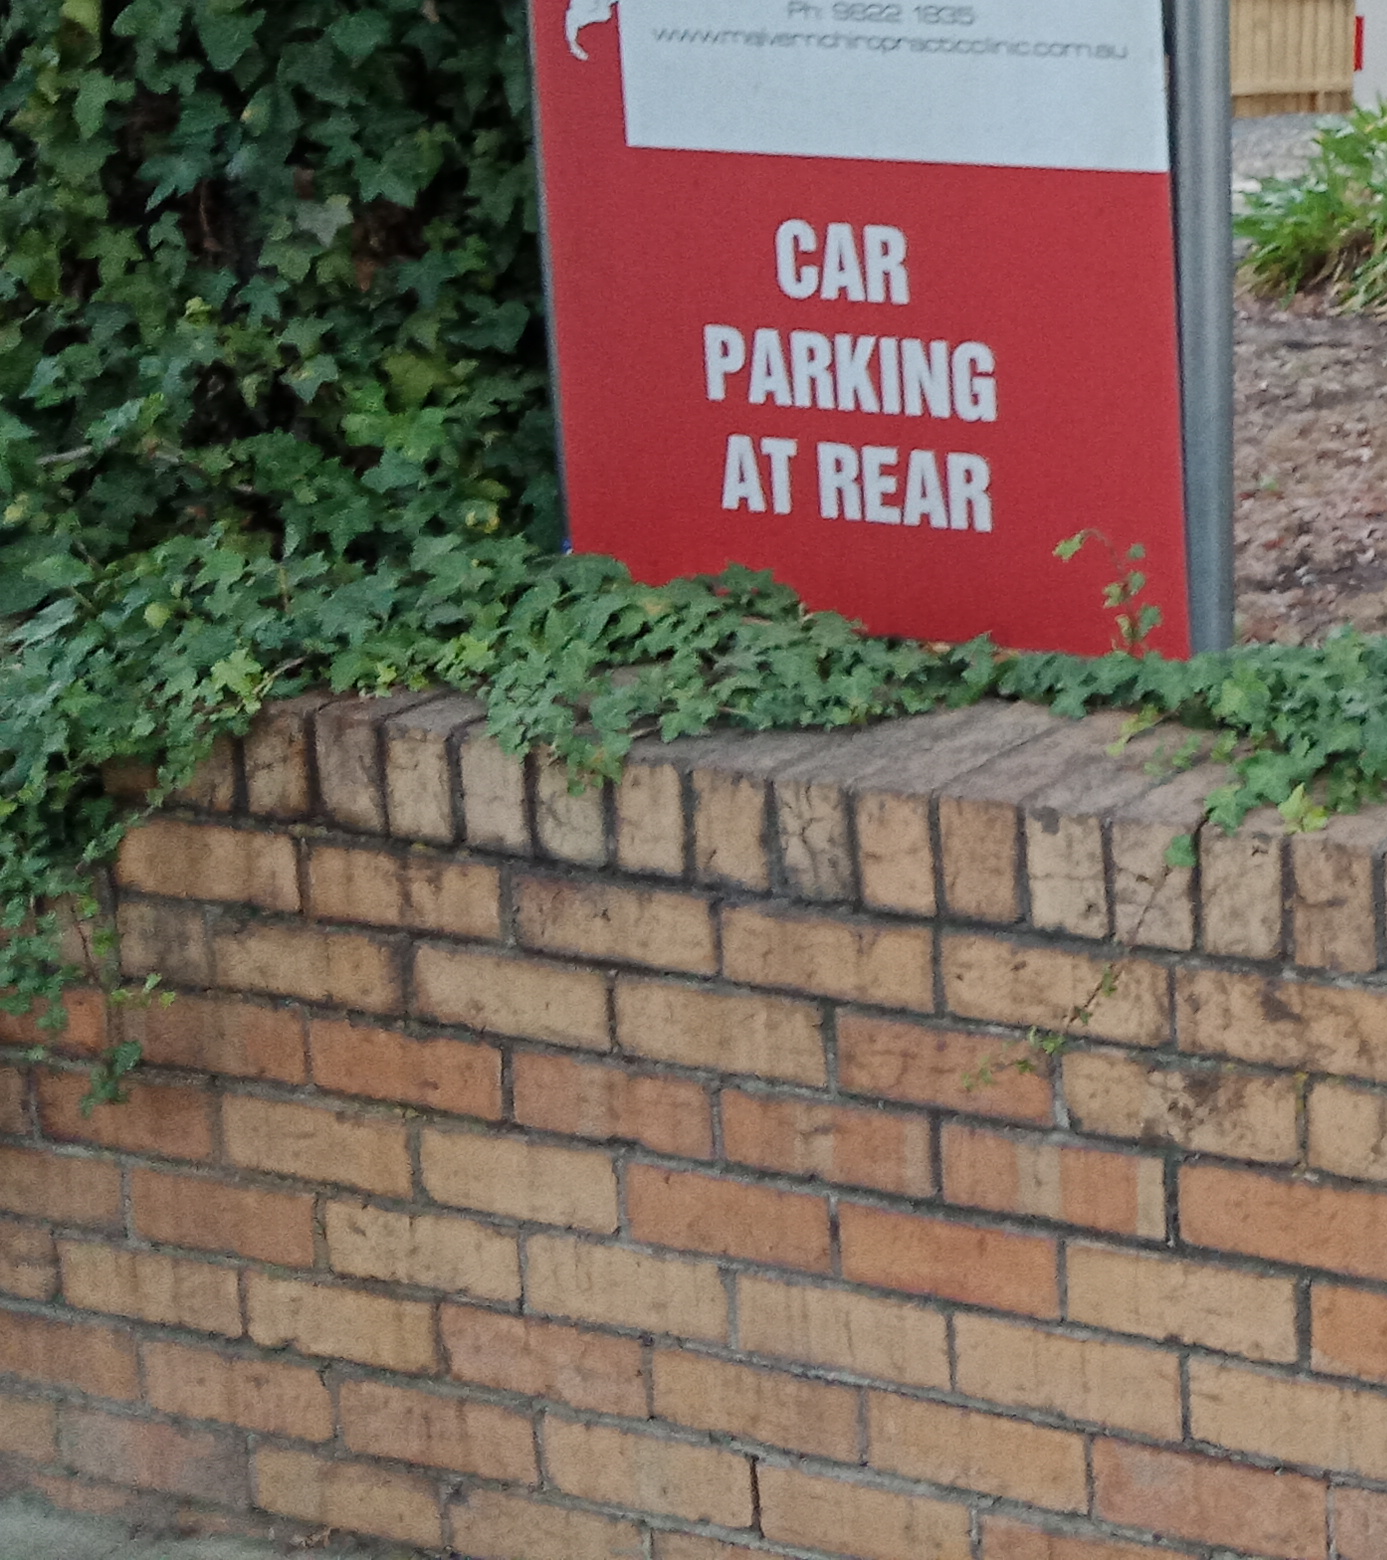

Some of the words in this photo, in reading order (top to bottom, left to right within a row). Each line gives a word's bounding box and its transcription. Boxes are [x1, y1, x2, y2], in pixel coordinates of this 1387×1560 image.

[775, 219, 910, 305] CAR
[703, 323, 998, 422] PARKING
[722, 434, 798, 515] AT
[817, 441, 993, 533] REAR
